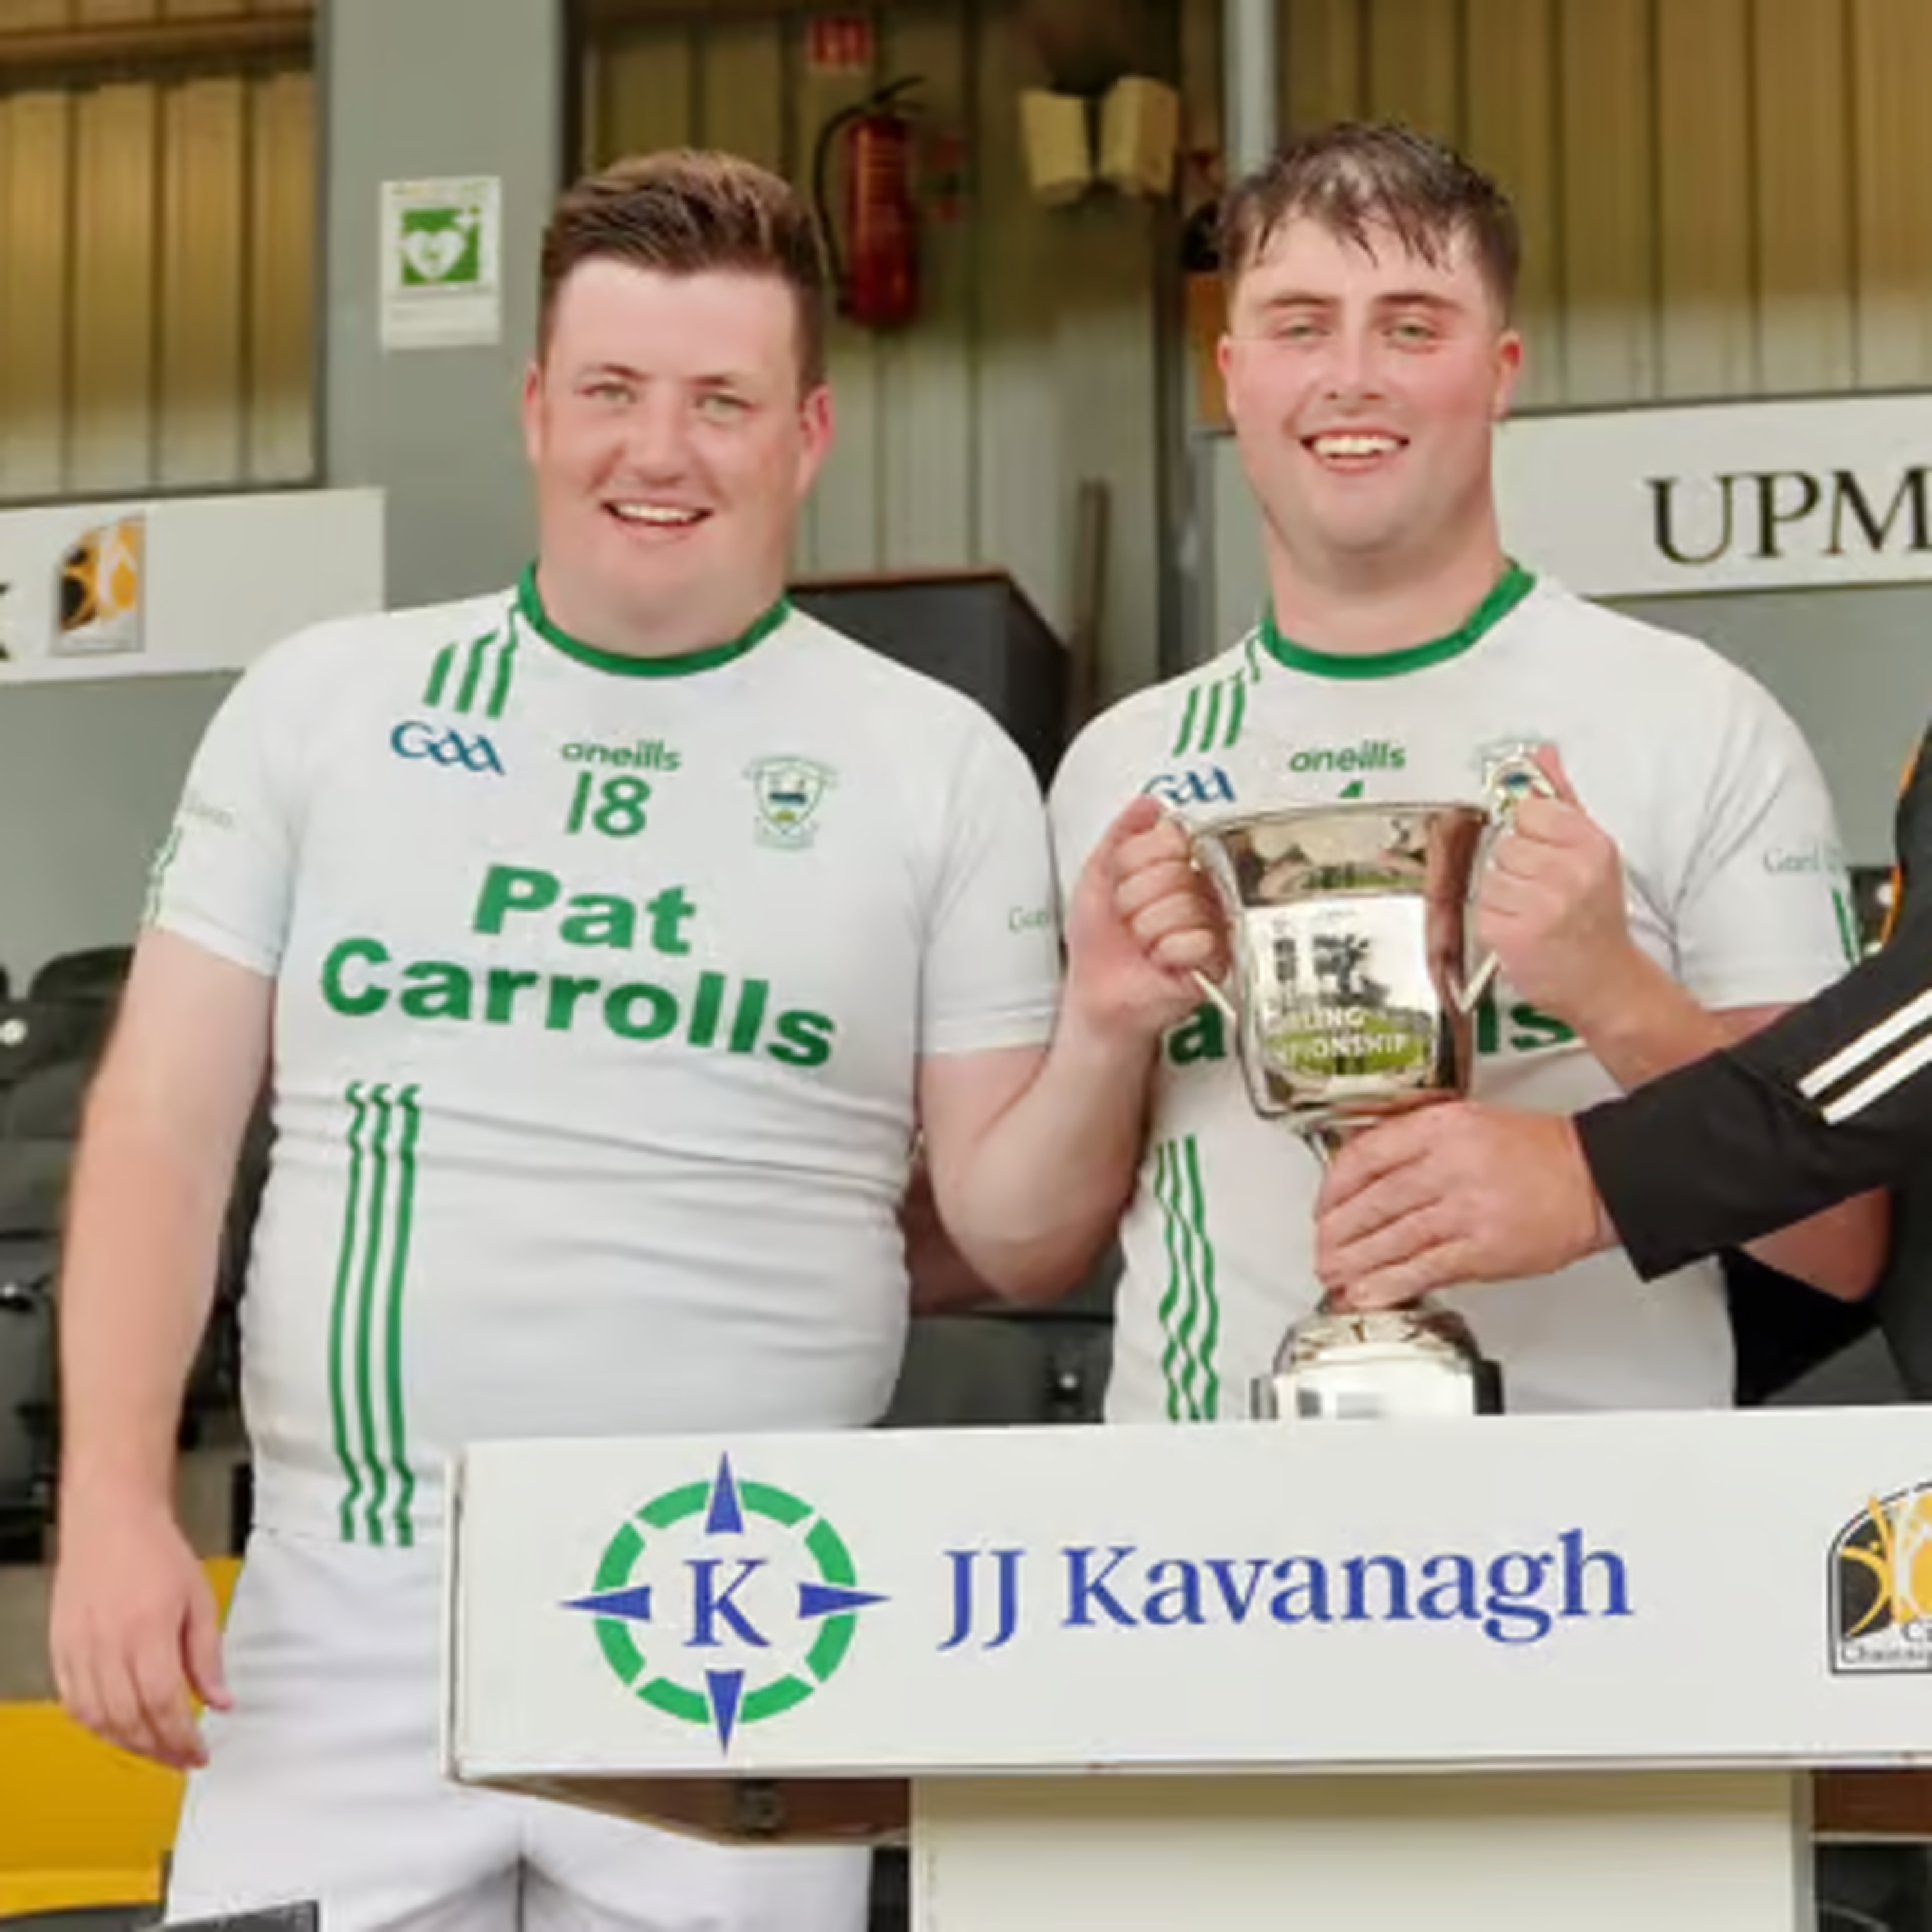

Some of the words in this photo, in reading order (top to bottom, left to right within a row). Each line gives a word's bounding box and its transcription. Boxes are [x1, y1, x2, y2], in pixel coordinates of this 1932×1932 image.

[1645, 466, 1932, 564] UPM
[567, 770, 651, 838] 18
[472, 864, 696, 956] Pat
[320, 937, 837, 1068] Carrolls
[682, 1558, 771, 1648] K
[938, 1549, 1024, 1650] JJ
[1060, 1528, 1634, 1643] Kavanagh
